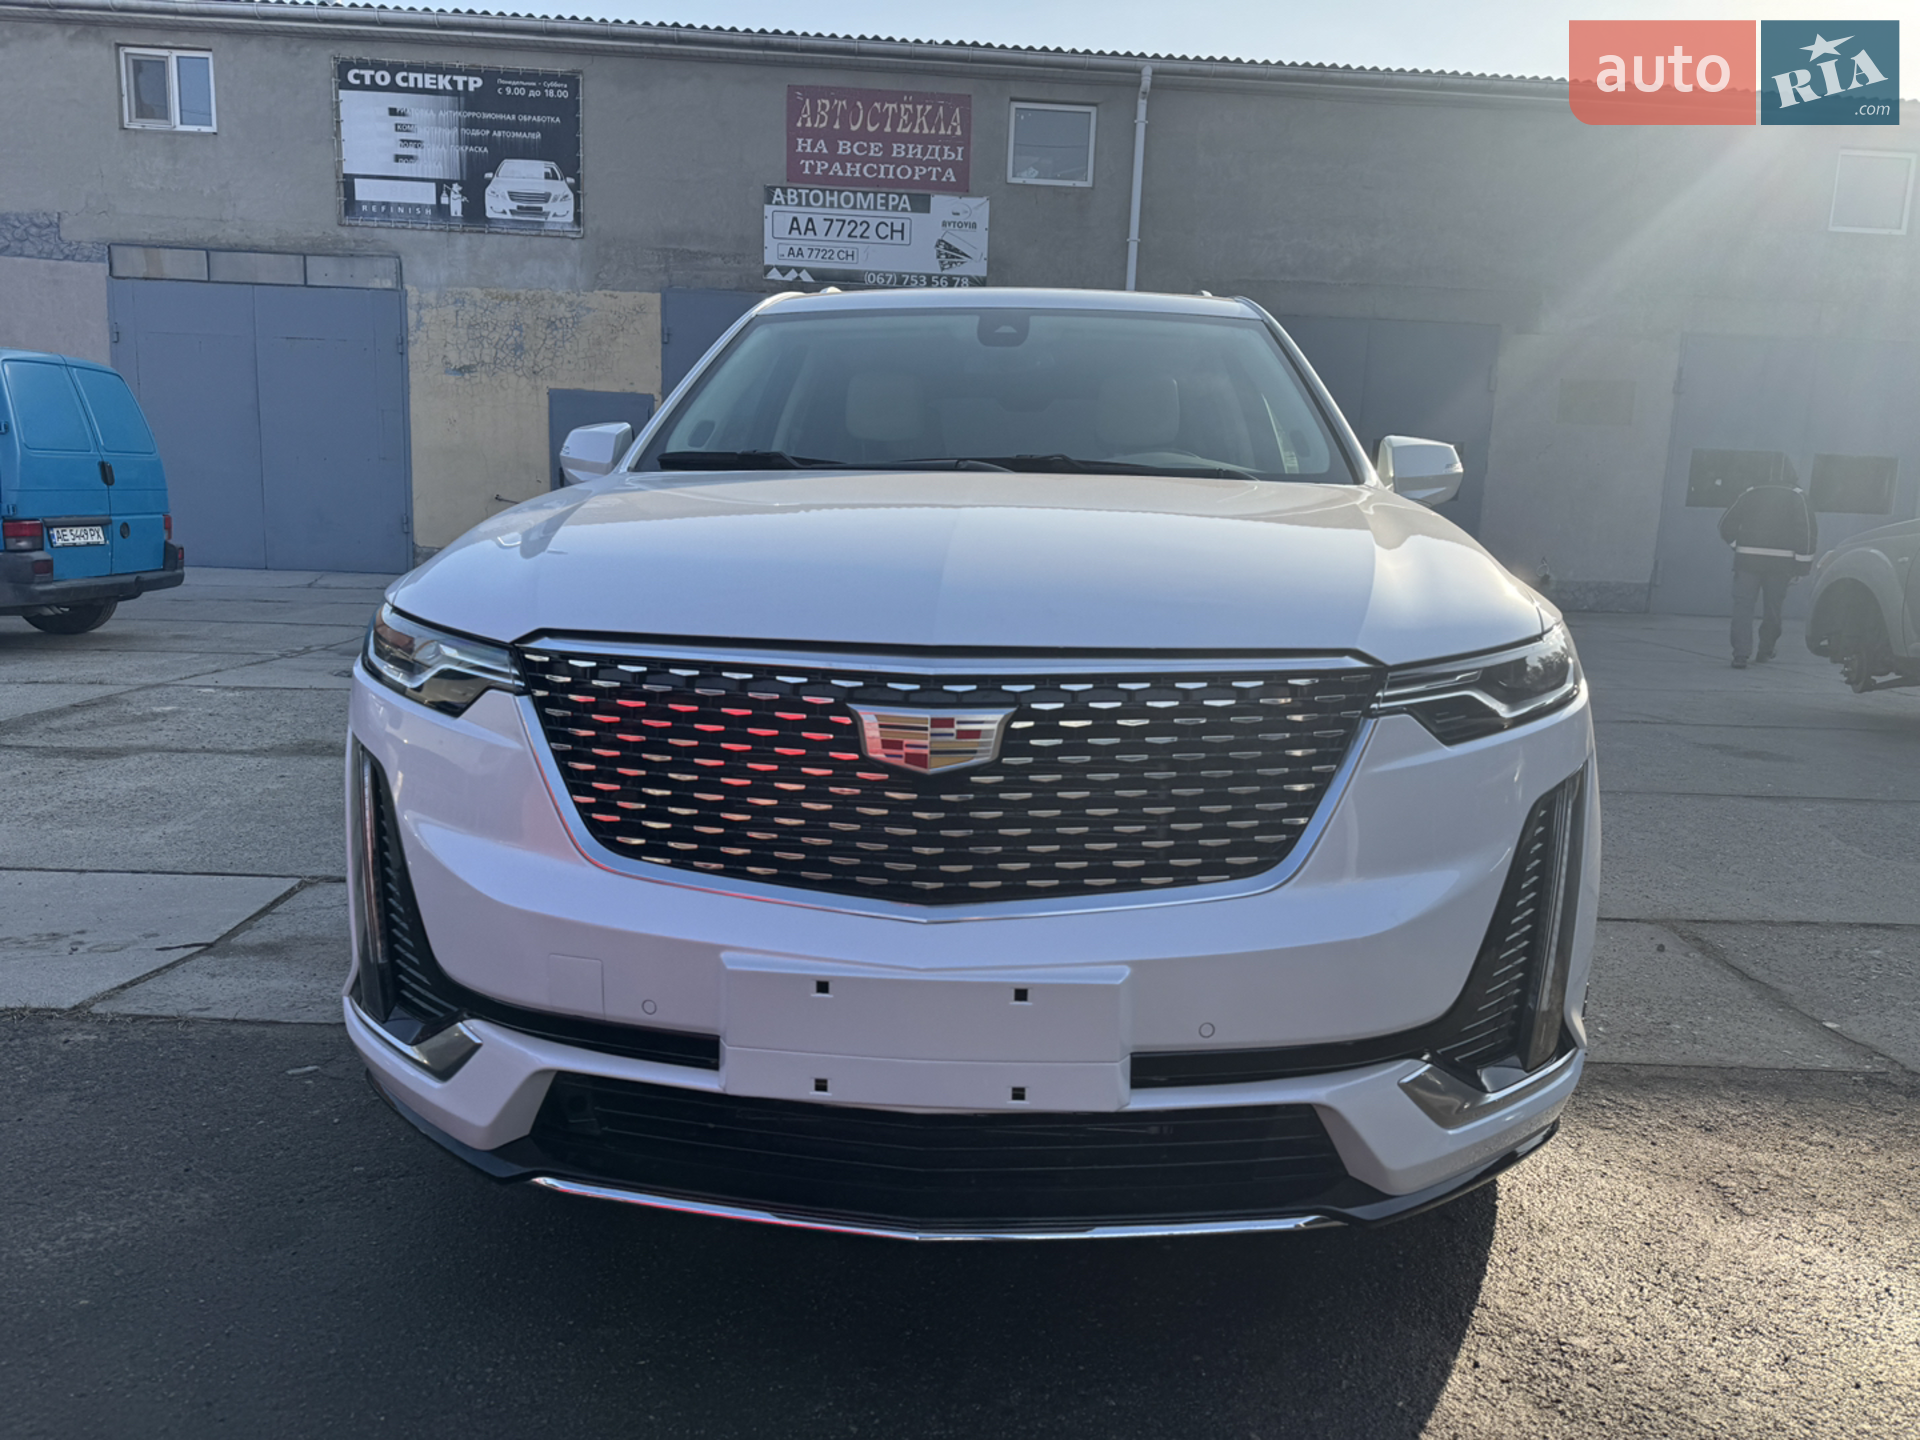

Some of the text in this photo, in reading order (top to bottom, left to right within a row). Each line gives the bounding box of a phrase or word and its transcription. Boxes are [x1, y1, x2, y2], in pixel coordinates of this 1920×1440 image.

[347, 69, 483, 92] СТО СПЕКТР
[505, 87, 526, 97] 9.00
[544, 88, 569, 99] 18.00
[517, 114, 561, 124] ОБРАБОТКА
[796, 96, 962, 135] АВТОСТЁКЛА
[460, 127, 490, 137] ПОДБОР
[491, 130, 542, 140] АВТОЭМАЛЕЙ
[795, 138, 965, 162] НА ВСЕ ВИДЫ
[799, 159, 957, 182] ТРАНСПОРТА
[771, 187, 912, 212] АВТОНОМЕРА
[361, 203, 433, 216] REFINISH
[788, 216, 905, 241] AA 7722 CH
[787, 246, 855, 261] AA 7722 CH
[863, 271, 970, 288] (067) 753 56 78
[56, 527, 102, 542] AE 5449 PX
